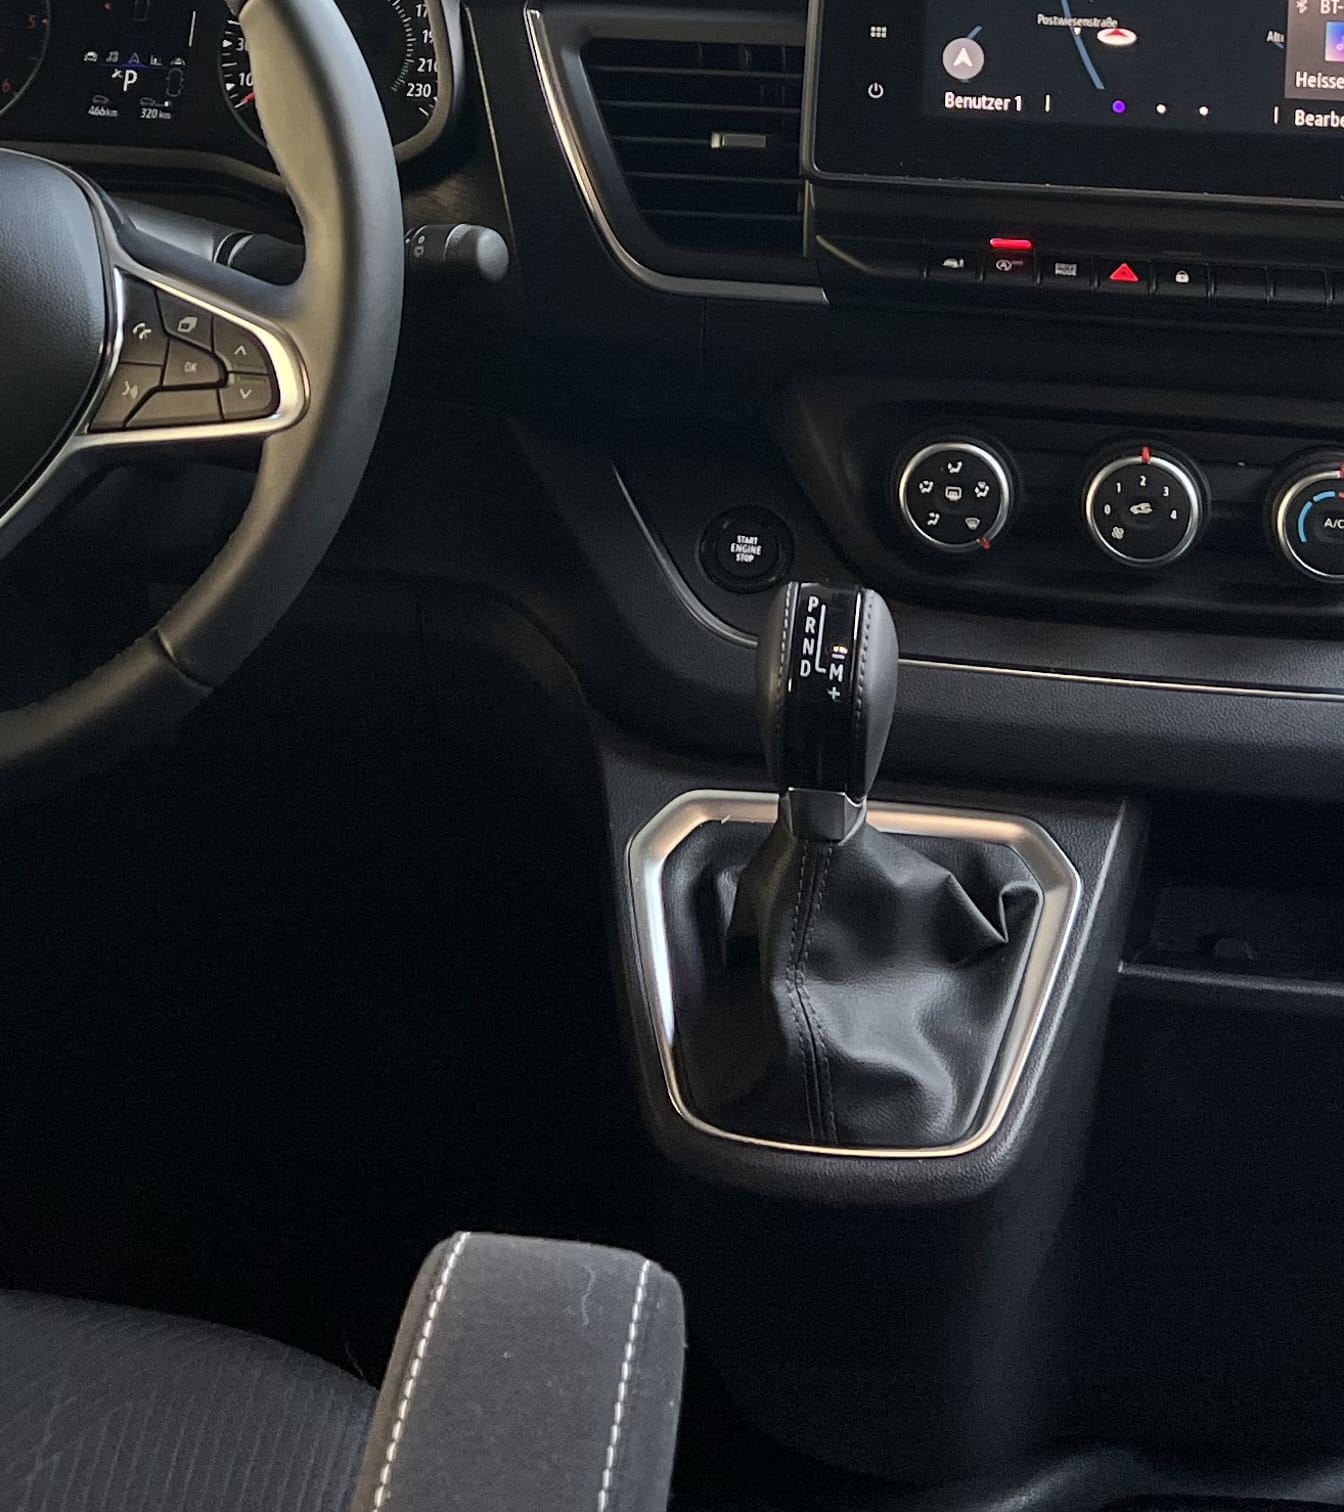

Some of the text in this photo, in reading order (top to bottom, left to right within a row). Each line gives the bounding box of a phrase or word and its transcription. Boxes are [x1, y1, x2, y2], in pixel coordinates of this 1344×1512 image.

[123, 69, 138, 92] P
[239, 72, 254, 87] 10
[406, 82, 431, 98] 230
[944, 91, 1023, 112] Benutzer 1
[184, 361, 198, 373] OK
[1116, 482, 1122, 494] 1
[1139, 475, 1147, 487] 2
[1162, 486, 1170, 498] 3
[1170, 508, 1177, 520] 4
[736, 534, 758, 545] START
[730, 542, 762, 556] ENGINE
[735, 552, 755, 563] STOP
[807, 595, 820, 613] P
[805, 616, 817, 634] R
[802, 637, 815, 656] N
[799, 659, 812, 678] D
[828, 663, 844, 682] M
